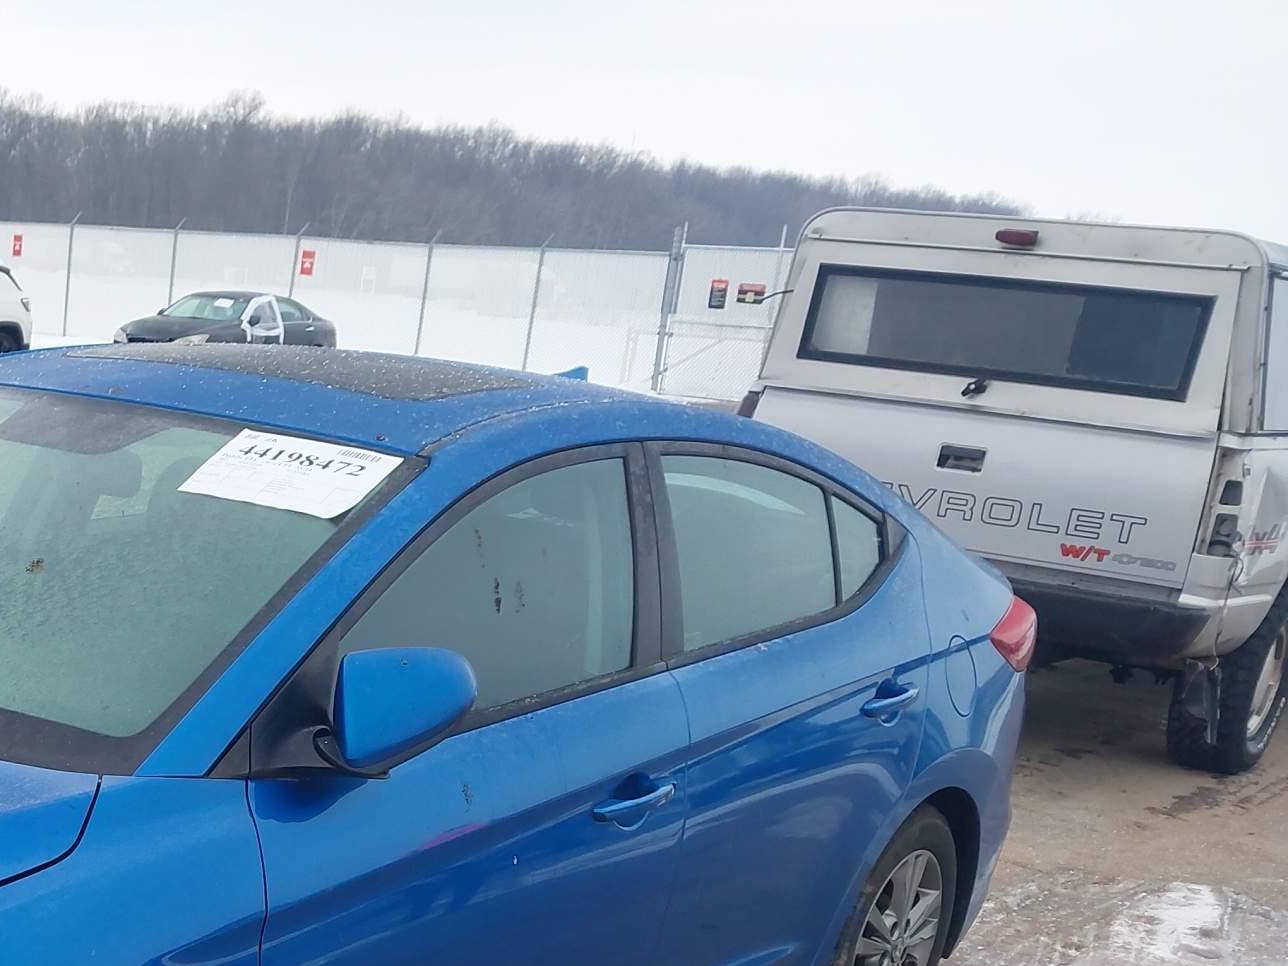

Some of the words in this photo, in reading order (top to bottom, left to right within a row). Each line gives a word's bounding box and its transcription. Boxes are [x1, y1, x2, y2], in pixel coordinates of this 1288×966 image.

[239, 444, 367, 477] 44198472
[880, 481, 1148, 545] VROLET
[1060, 543, 1111, 562] W/T
